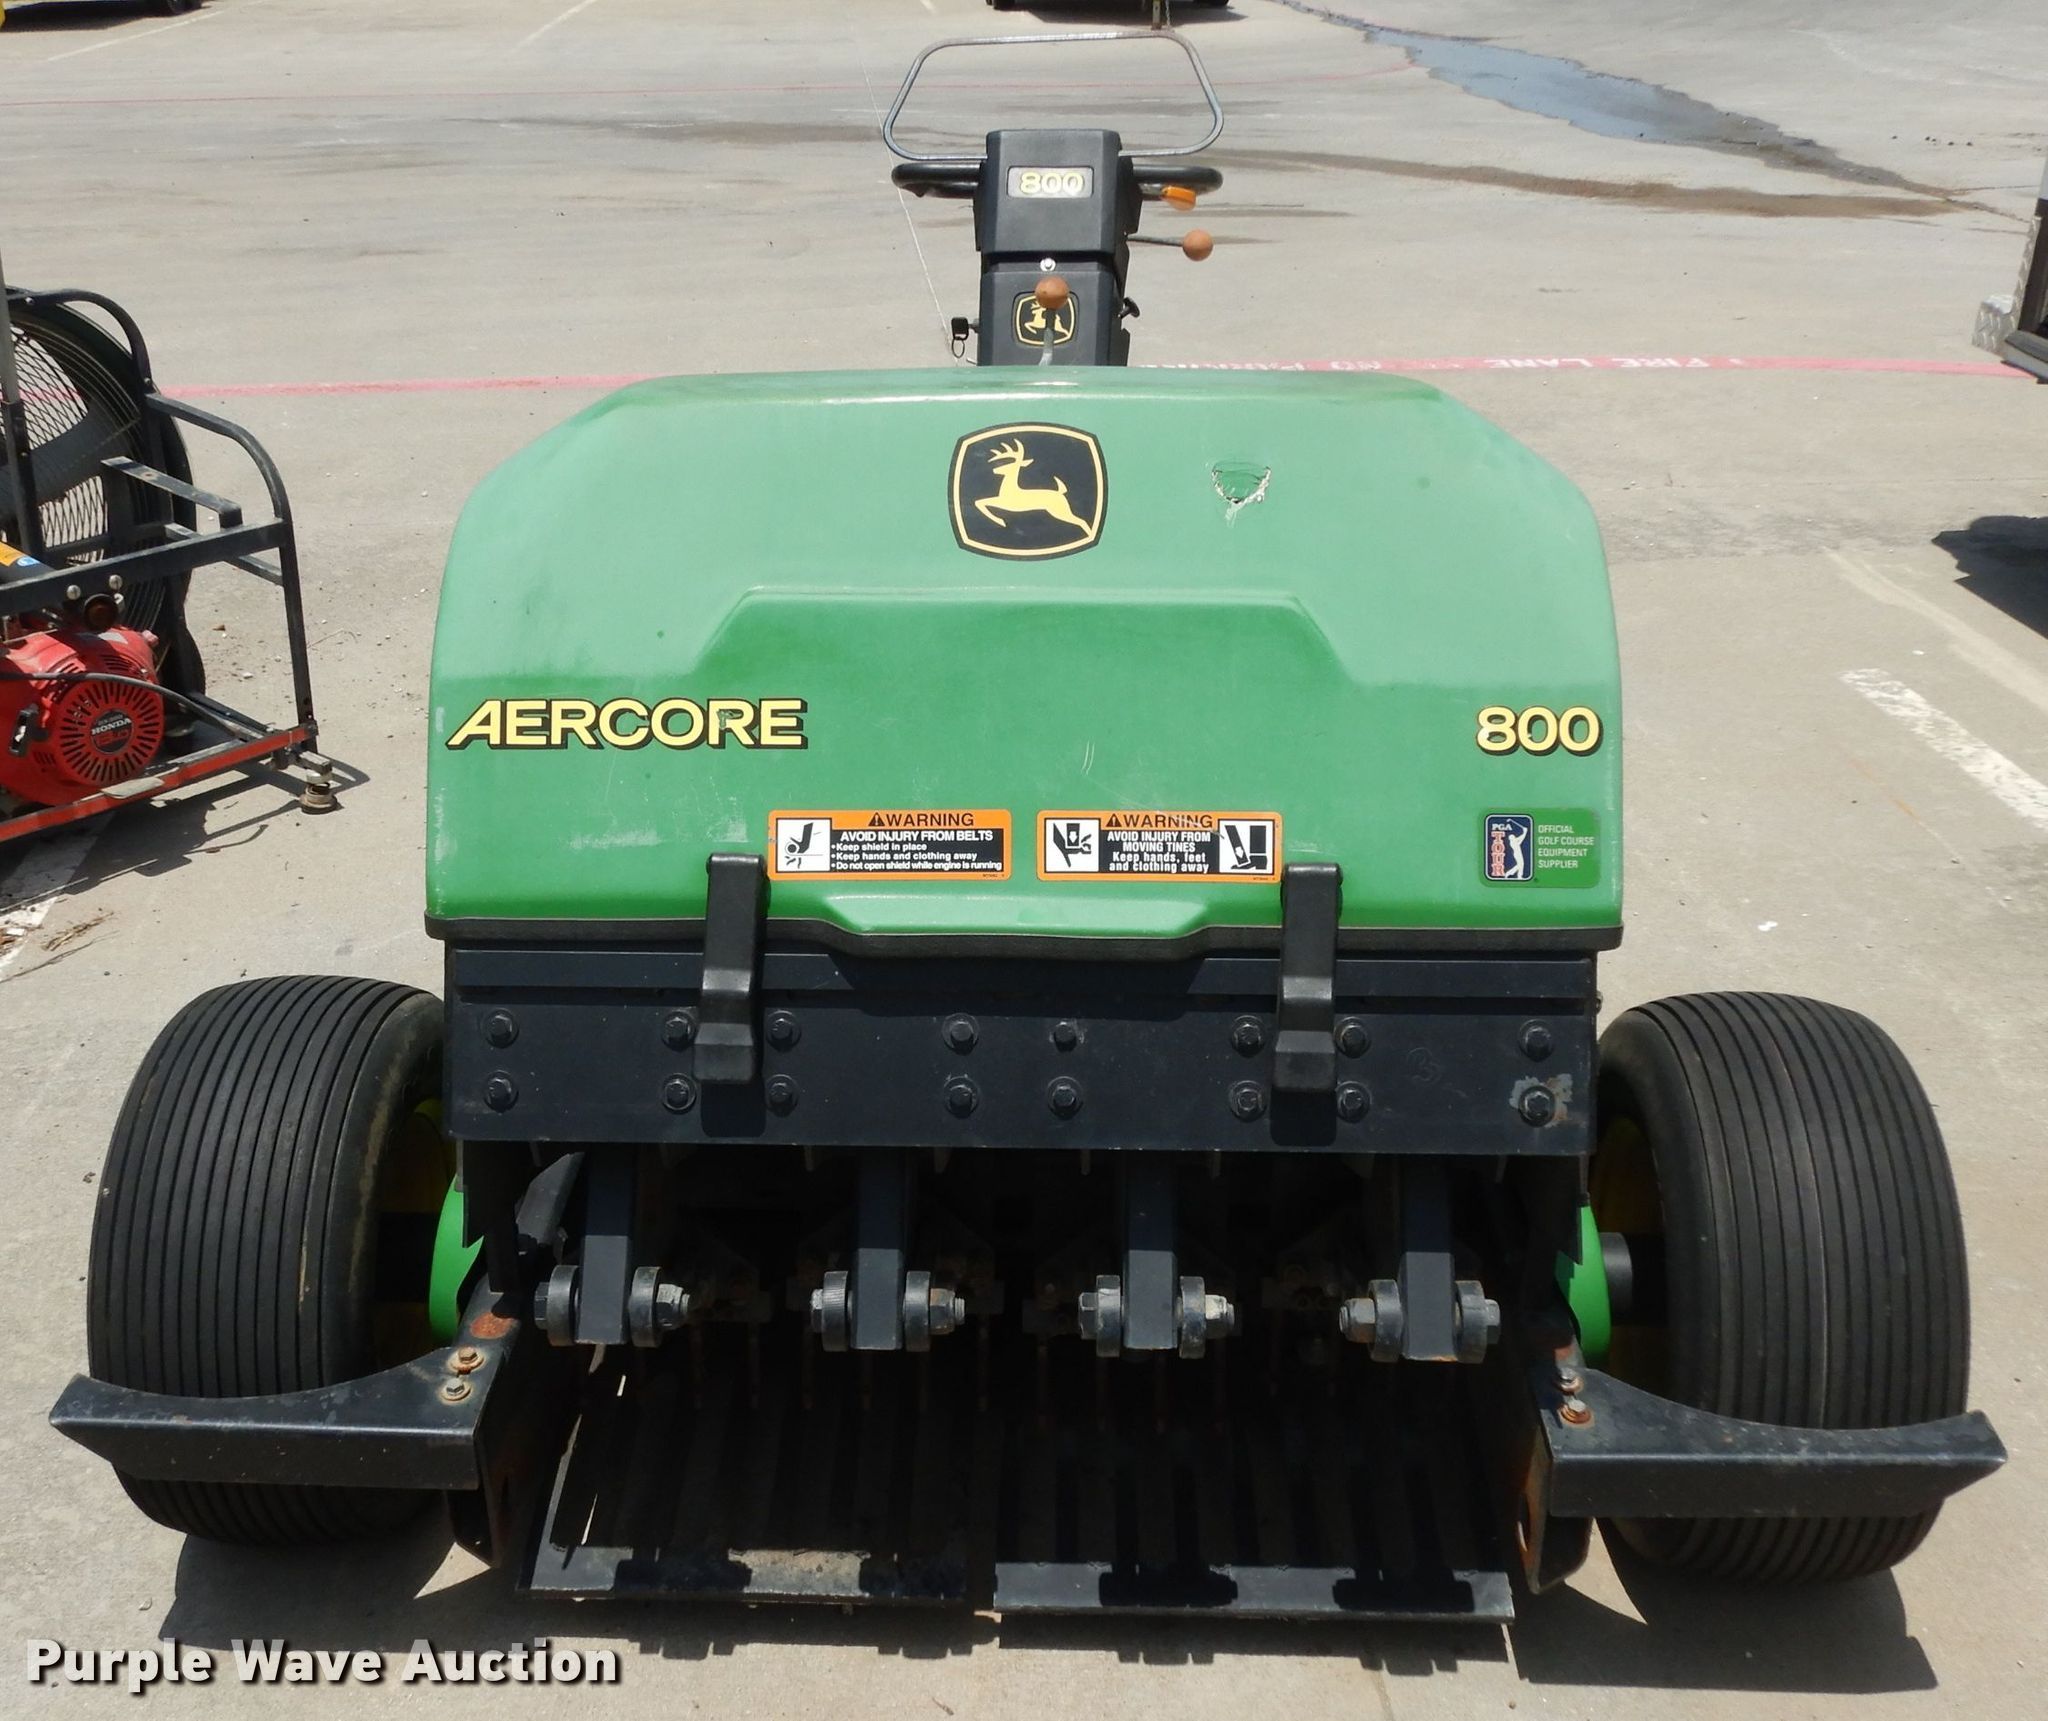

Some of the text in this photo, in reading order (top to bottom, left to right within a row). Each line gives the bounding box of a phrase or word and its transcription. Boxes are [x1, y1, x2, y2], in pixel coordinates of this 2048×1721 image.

[1020, 172, 1085, 194] 800
[91, 718, 132, 735] HONDA
[446, 698, 808, 749] AERCORE
[1476, 706, 1604, 757] 800
[886, 813, 974, 827] WARNING
[1123, 814, 1213, 828] WARNING
[1538, 825, 1574, 834] OFFICIAL
[840, 831, 993, 842] AVOID INJURY FROM BELTS
[1107, 831, 1211, 842] AVOID INJURY FROM
[1538, 837, 1595, 845] GOLF COURSE
[836, 843, 927, 852] Keep shield in place
[1122, 842, 1196, 852] MOVING TINES
[1538, 848, 1588, 857] EQUIPMENT
[836, 852, 977, 861] Keep hands and clothing away
[1112, 852, 1206, 863] Keep hands, feet
[1491, 831, 1506, 877] TOUR
[836, 862, 848, 870] Do
[850, 862, 863, 870] not
[864, 862, 885, 871] open
[886, 861, 910, 870] shield
[911, 861, 933, 870] while
[934, 862, 961, 870] engine
[971, 862, 1002, 870] running
[1109, 862, 1209, 874] and clothing away
[1538, 860, 1579, 868] SUPPLIER
